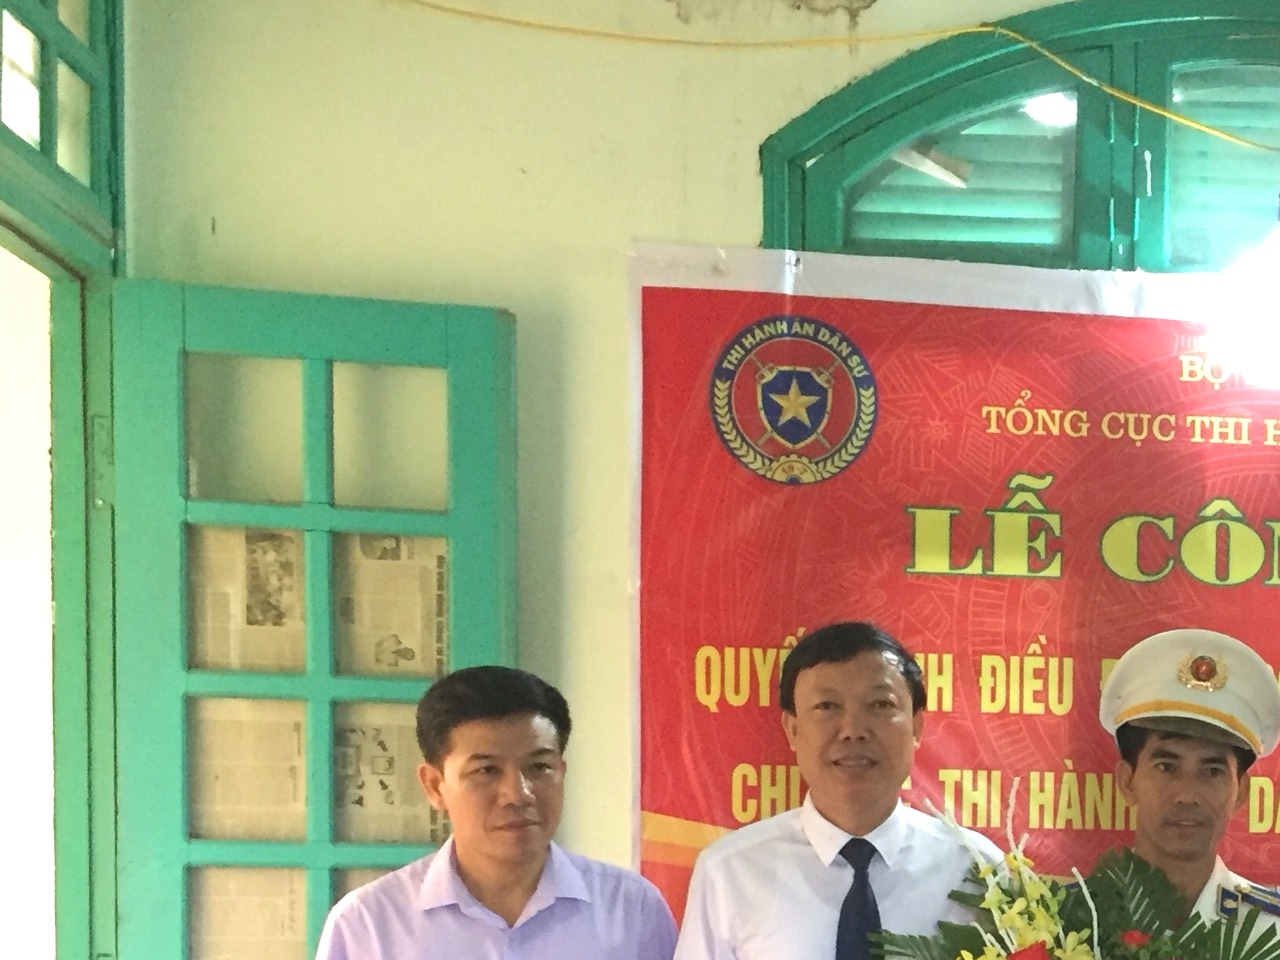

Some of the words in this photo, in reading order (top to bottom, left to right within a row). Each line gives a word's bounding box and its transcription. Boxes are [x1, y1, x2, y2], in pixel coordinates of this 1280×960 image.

[722, 345, 746, 371] THI
[741, 320, 788, 351] HÀNH
[790, 318, 816, 337] ÁN
[817, 327, 853, 357] DÂN
[847, 355, 871, 379] SỰ
[981, 389, 1091, 438] TỔNG
[1101, 412, 1177, 448] CỤC
[1186, 414, 1253, 446] THI
[905, 472, 1063, 579] LỄ
[979, 634, 1075, 716] ĐIỀU
[938, 768, 1002, 828] THI
[1028, 758, 1139, 831] HÀNH
